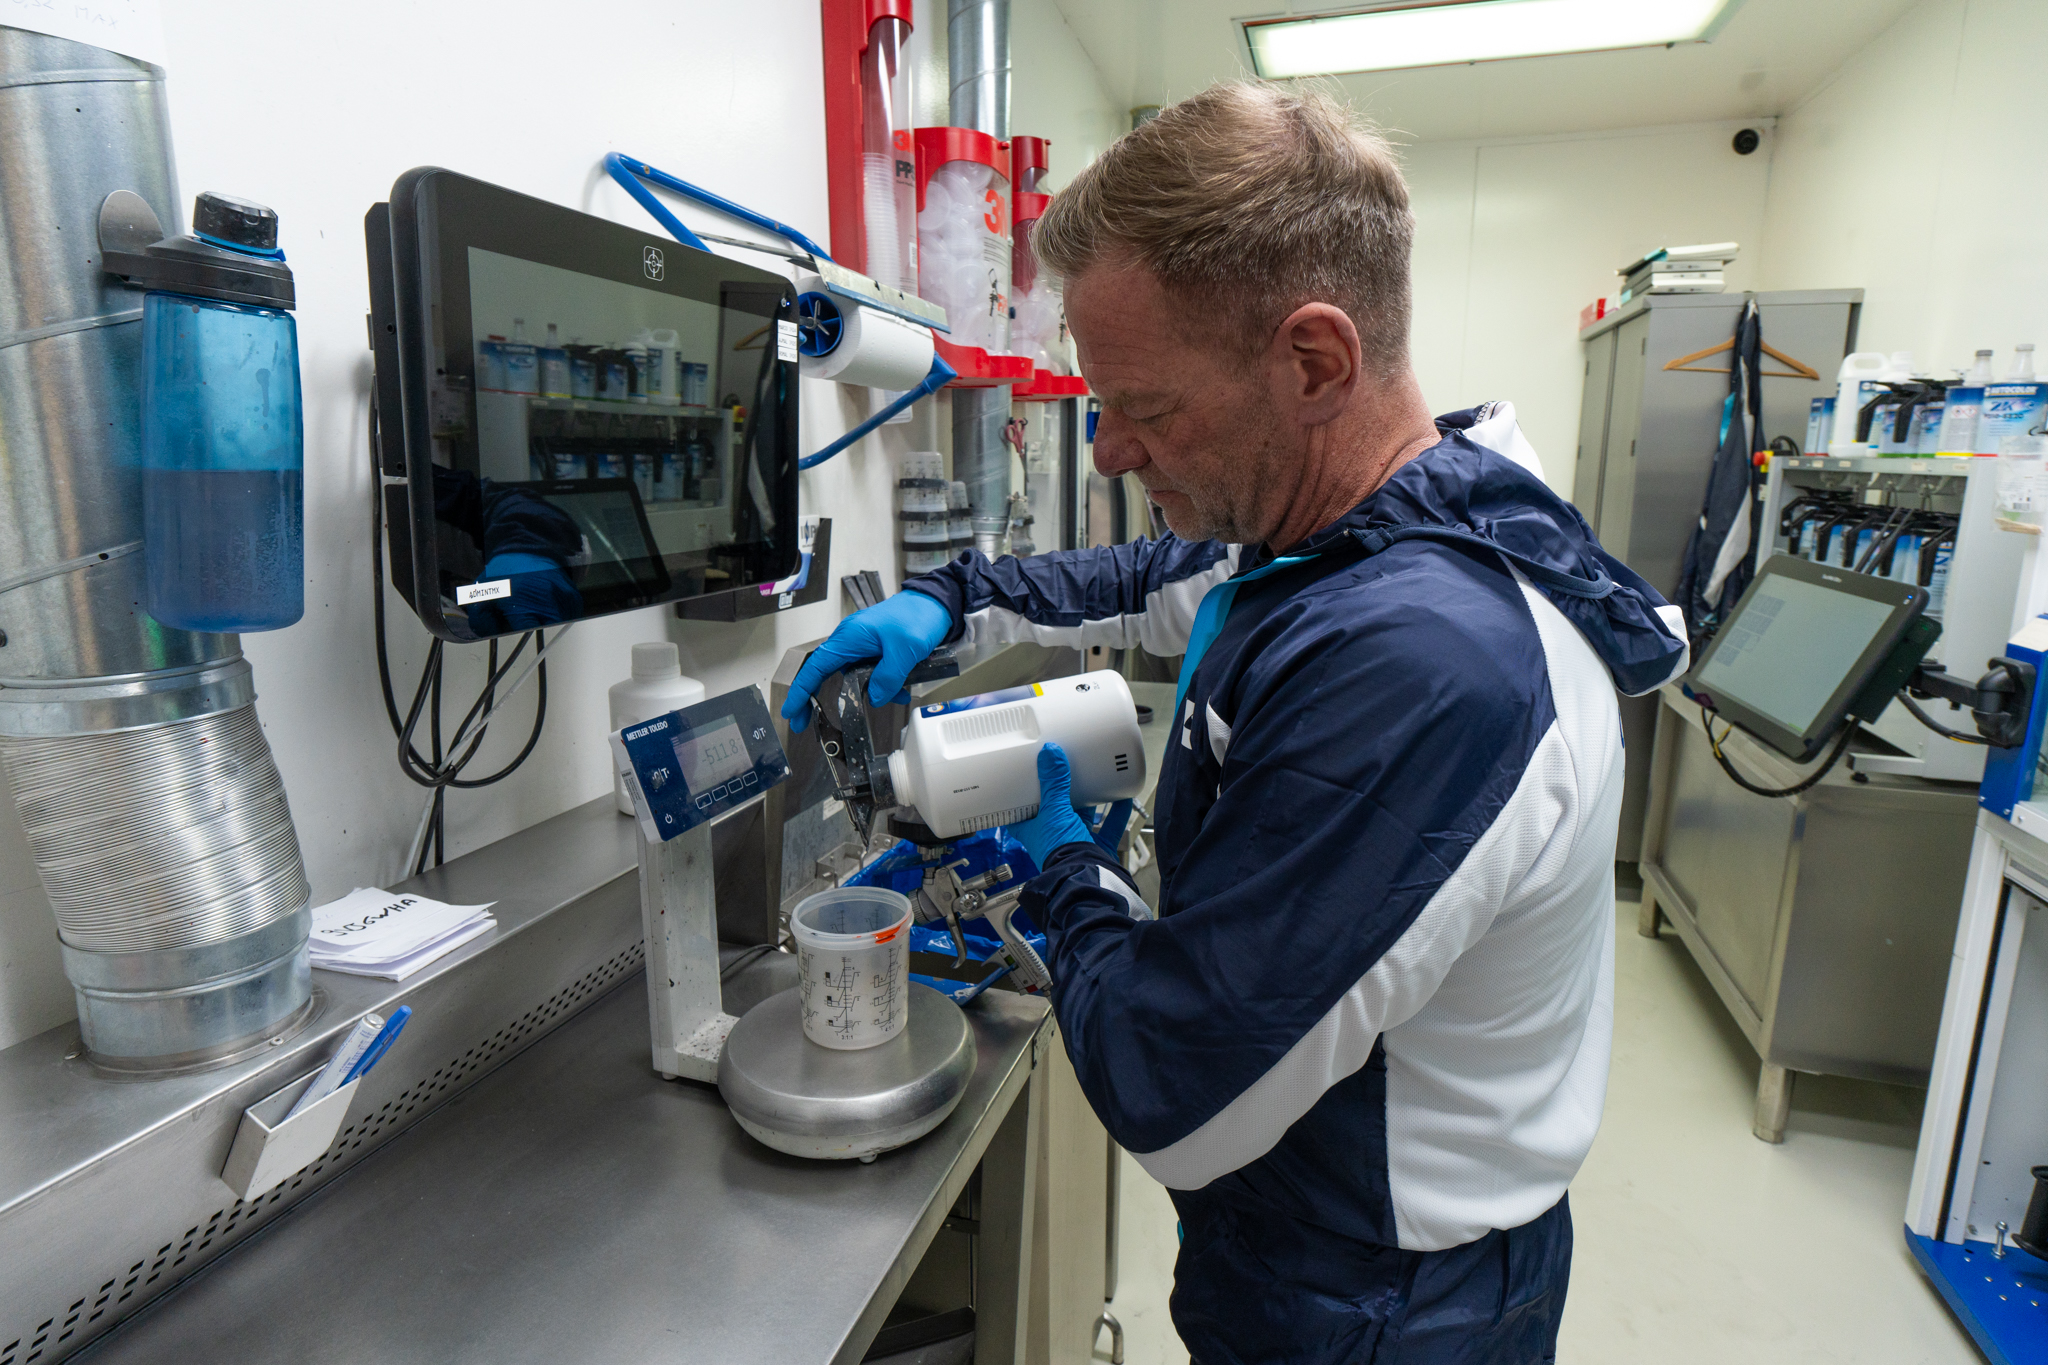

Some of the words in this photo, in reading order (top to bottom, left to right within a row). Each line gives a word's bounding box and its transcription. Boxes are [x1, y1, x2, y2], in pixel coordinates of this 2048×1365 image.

[469, 587, 501, 599] ADMINTMX
[626, 727, 650, 742] METTLER
[648, 720, 669, 734] TOLEDO
